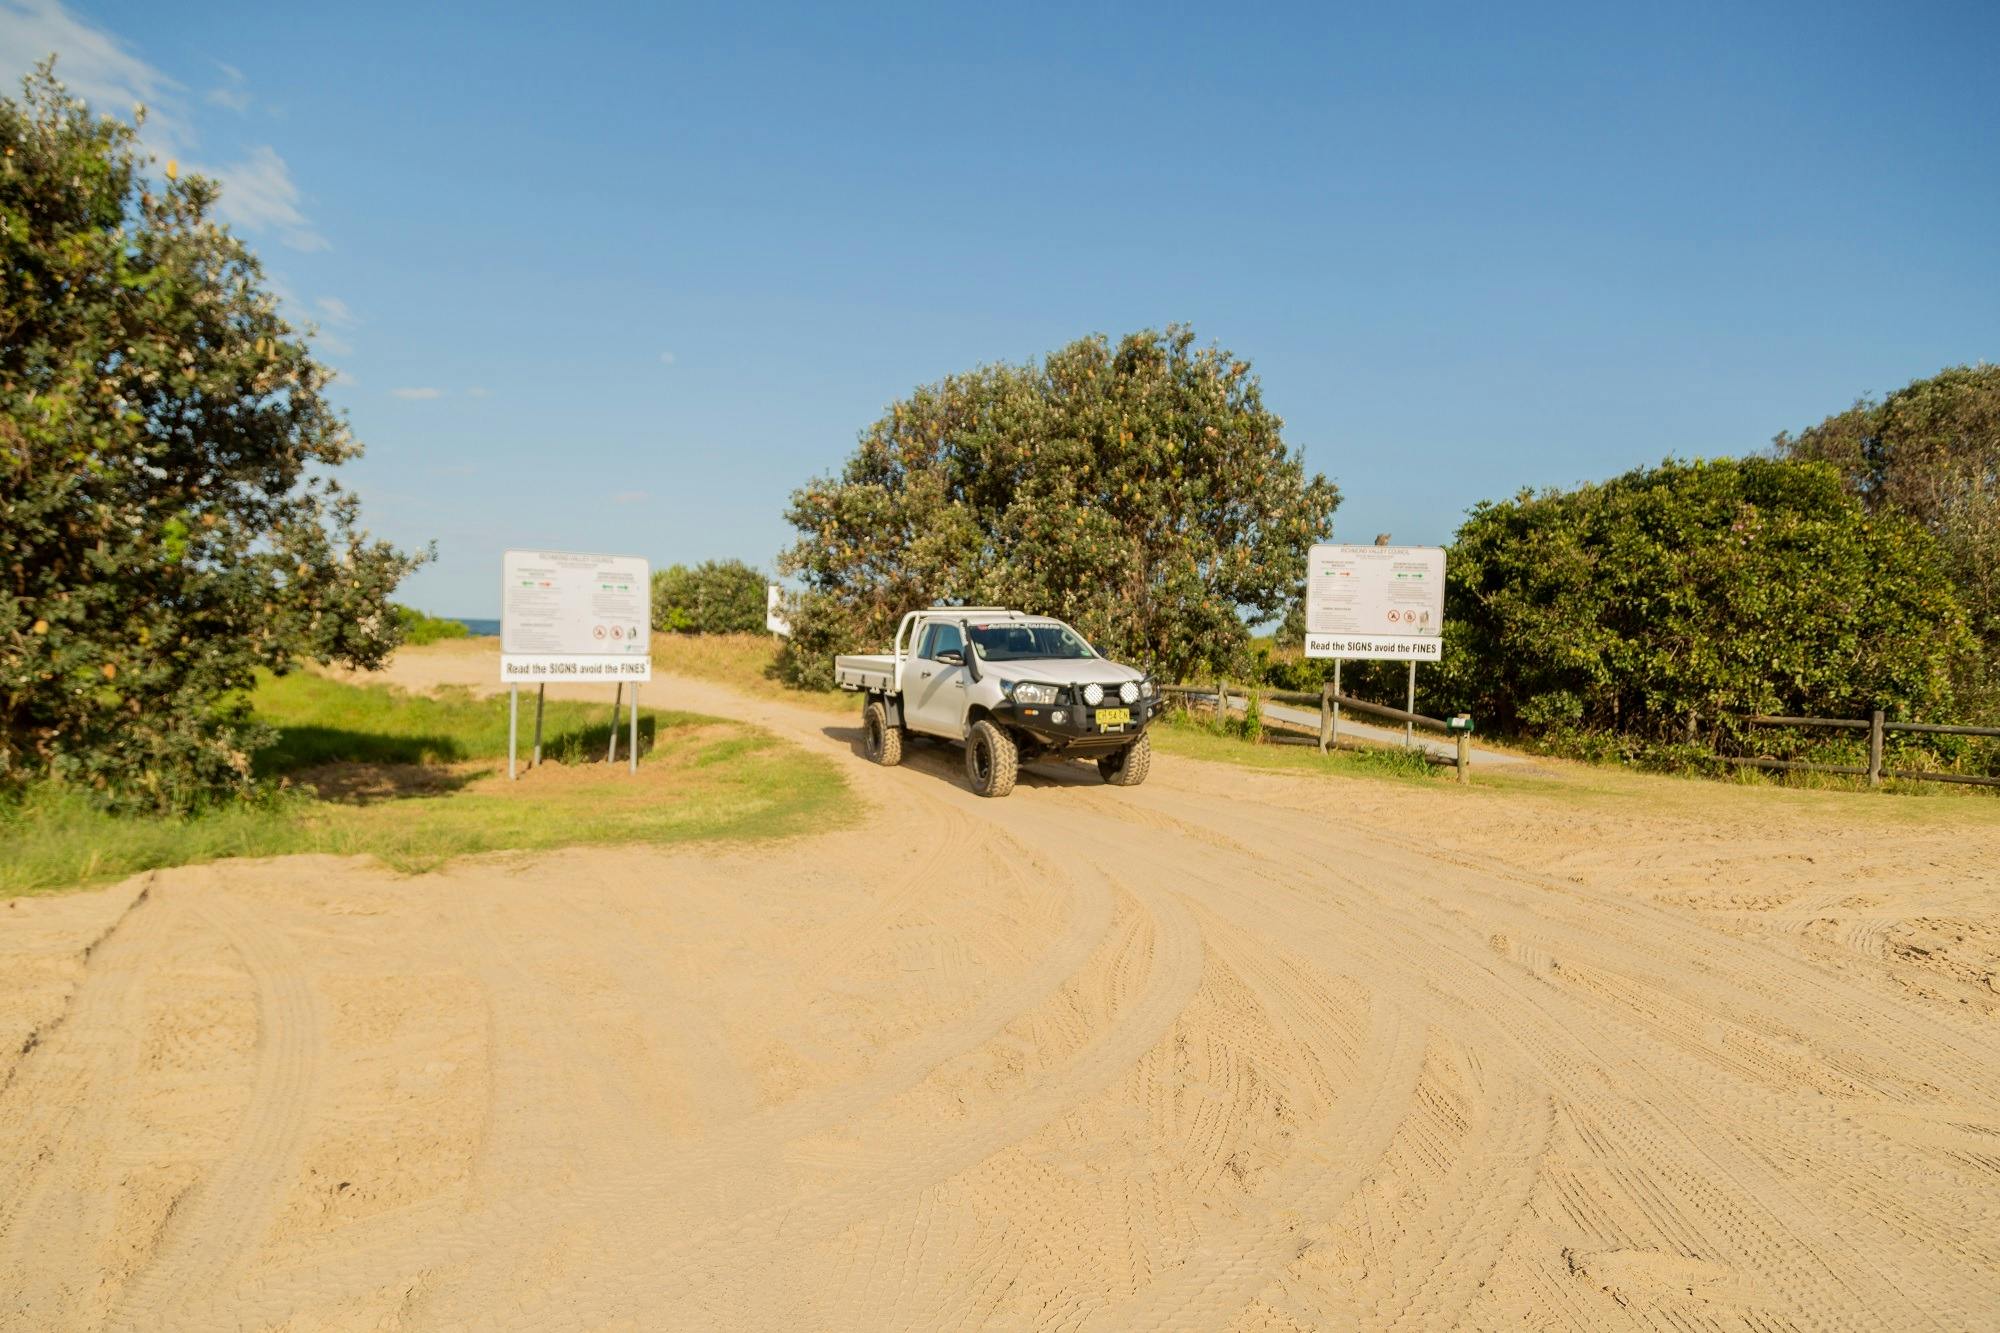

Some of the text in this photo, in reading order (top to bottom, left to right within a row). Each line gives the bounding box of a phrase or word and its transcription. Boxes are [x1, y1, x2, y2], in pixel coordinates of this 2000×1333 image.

[1310, 640, 1437, 653] Read the SIGNS avoid the FINES
[506, 662, 646, 674] Read the SIGNS avoid the FINES
